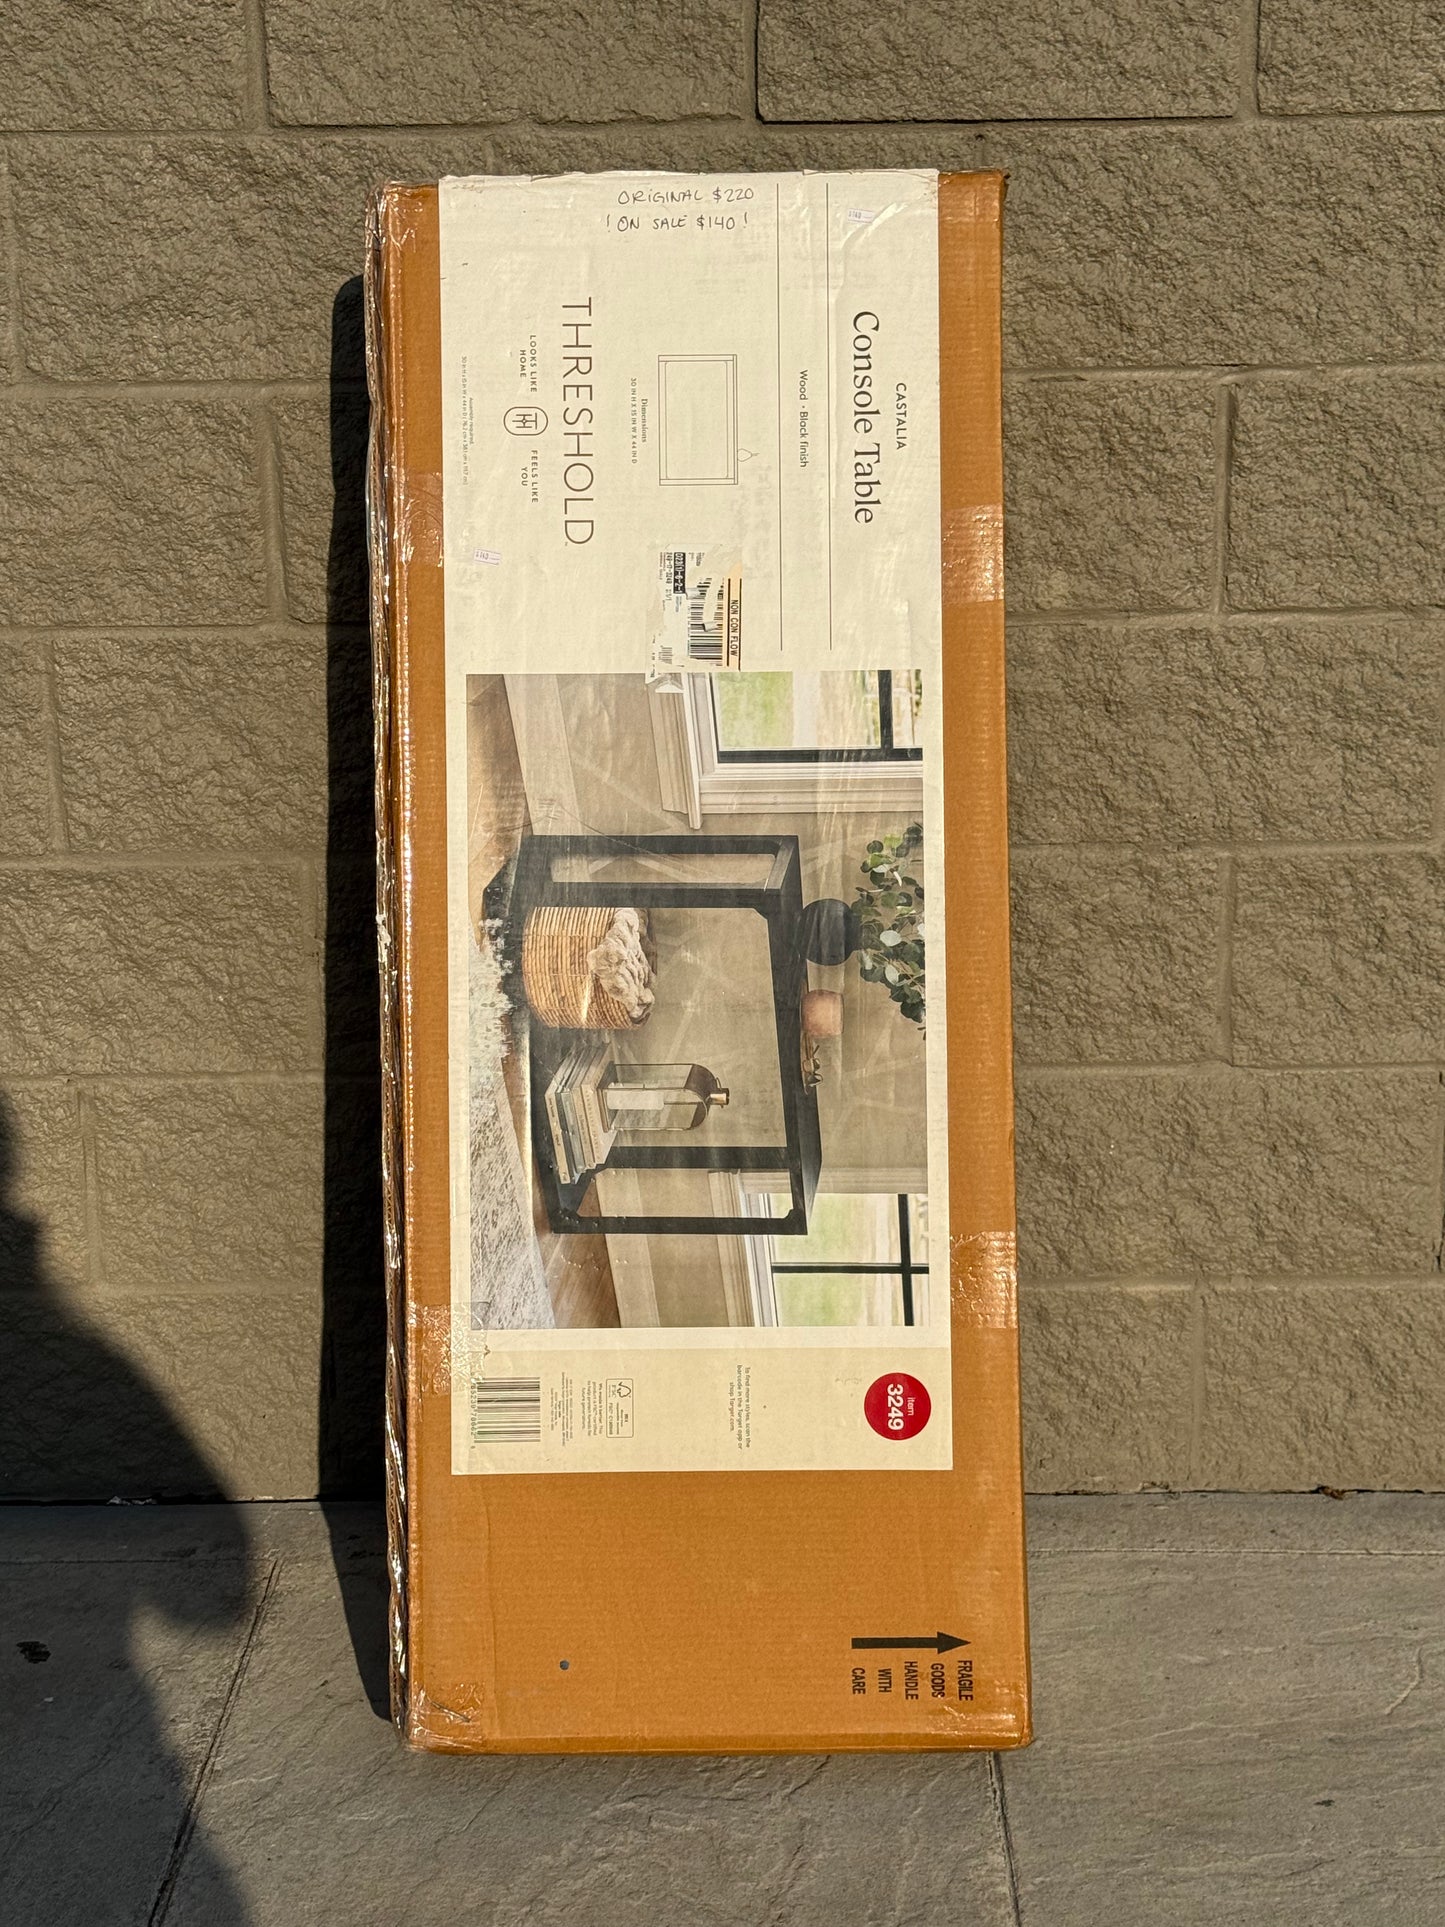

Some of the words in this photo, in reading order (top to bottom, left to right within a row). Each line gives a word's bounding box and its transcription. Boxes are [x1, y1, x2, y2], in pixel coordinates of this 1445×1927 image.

[713, 187, 754, 203] $220
[617, 216, 639, 231] ON
[653, 215, 687, 230] SALE
[697, 215, 735, 230] $140
[519, 350, 527, 377] HOME
[529, 336, 537, 368] LOOKS
[631, 378, 637, 386] 30
[799, 370, 808, 400] Wood
[853, 311, 881, 434] Console
[562, 297, 594, 545] THRESHOLD
[640, 399, 648, 442] Dimensions
[799, 412, 808, 438] Black
[896, 383, 907, 450] CASTALIA
[631, 441, 637, 449] 44
[799, 441, 808, 467] finish
[531, 482, 539, 503] LIKE
[854, 443, 881, 524] Table
[730, 600, 738, 614] NON
[730, 618, 738, 633] CON
[730, 636, 738, 656] FLOW
[887, 1383, 903, 1430] 3249
[907, 1397, 916, 1416] item
[852, 1668, 865, 1694] CARE
[878, 1669, 891, 1692] WITH
[904, 1661, 918, 1700] HANDLE
[931, 1663, 945, 1697] GOODS
[958, 1660, 973, 1701] FRAGILE
